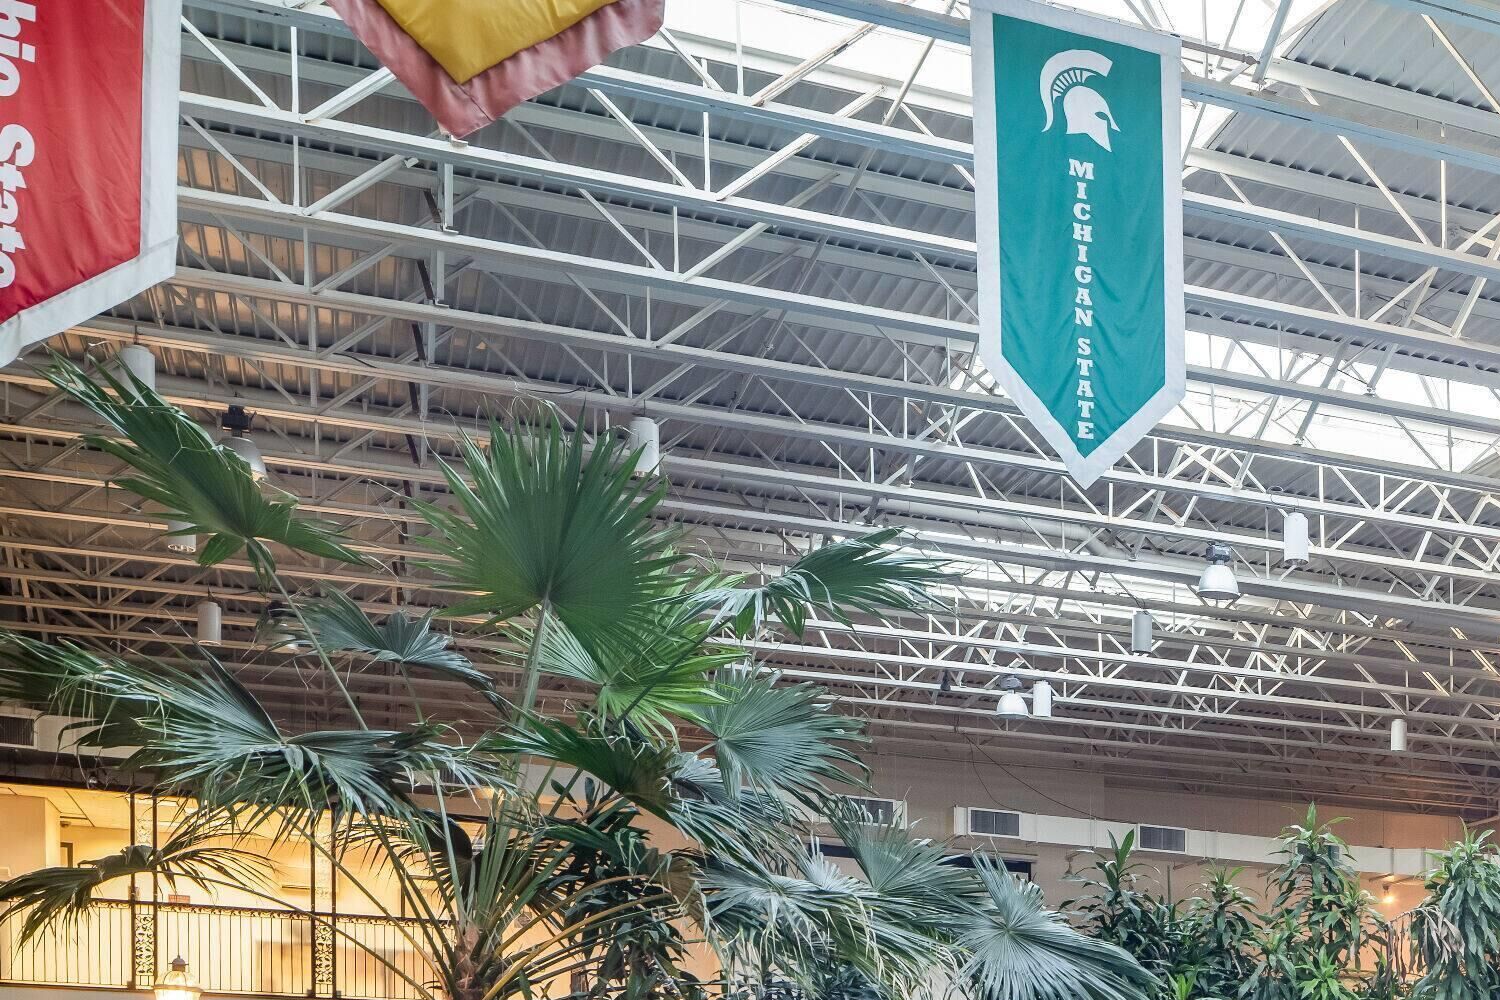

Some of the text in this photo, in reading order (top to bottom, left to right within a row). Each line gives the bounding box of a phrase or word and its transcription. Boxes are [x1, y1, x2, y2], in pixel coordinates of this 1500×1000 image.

[0, 0, 37, 96] hio
[1068, 158, 1095, 440] MICHIGAN STATE
